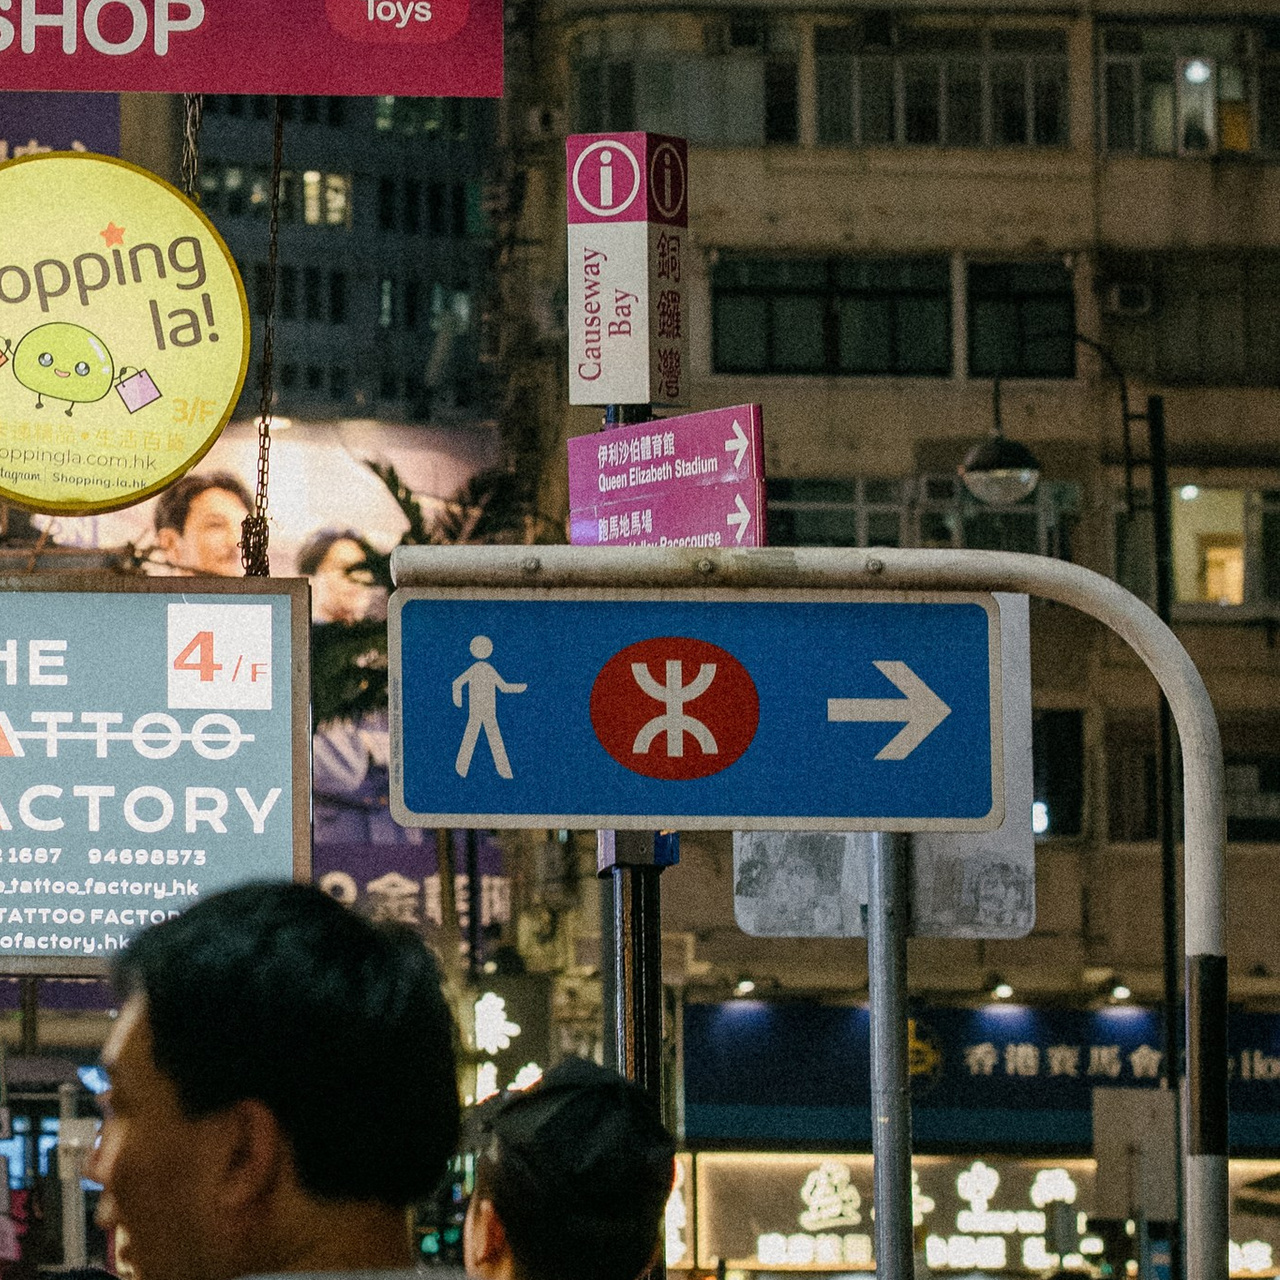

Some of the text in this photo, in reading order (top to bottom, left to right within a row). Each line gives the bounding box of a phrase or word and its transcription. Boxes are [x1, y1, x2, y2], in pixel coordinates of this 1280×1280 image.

[148, 292, 220, 351] la!
[577, 246, 608, 382] Causeway
[609, 287, 639, 338] Bay
[655, 230, 683, 399] 銅鑼灣
[170, 396, 219, 428] 3/F
[597, 430, 676, 470] 伊利沙伯體育館
[597, 455, 718, 493] Queen Elizabeth Stadium
[597, 508, 654, 543] 跑馬地馬場
[172, 630, 269, 684] 4/F
[964, 1041, 1164, 1078] 香港賽馬會
